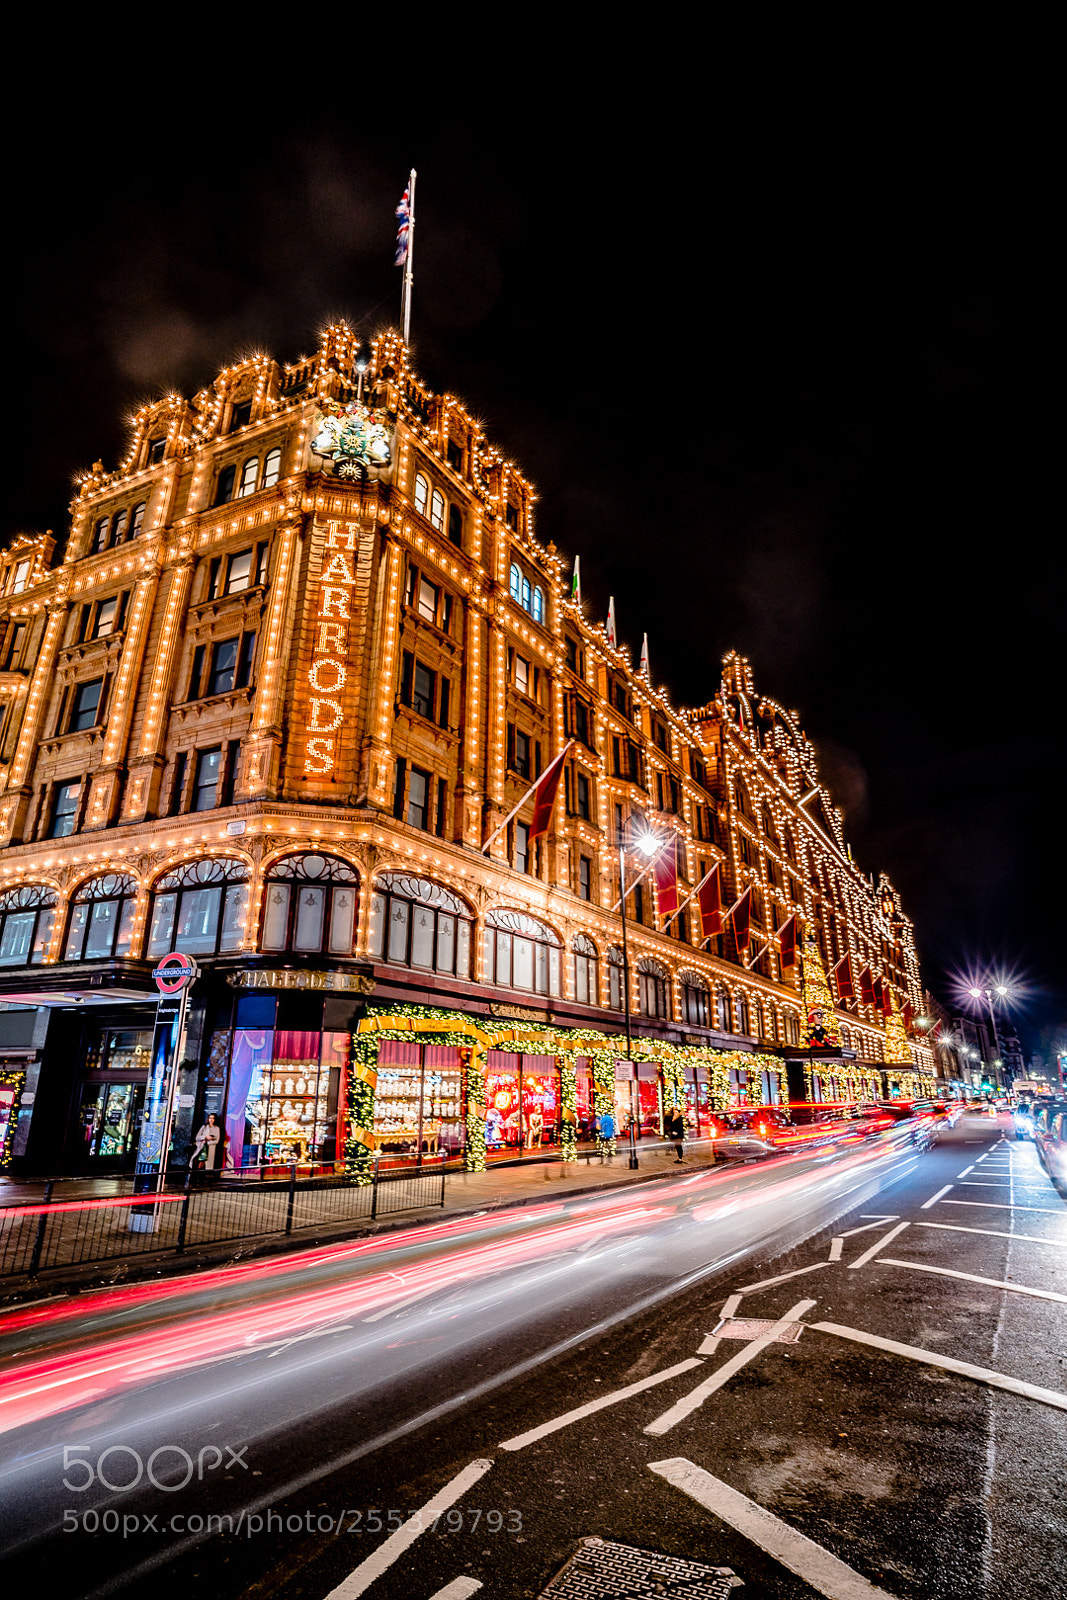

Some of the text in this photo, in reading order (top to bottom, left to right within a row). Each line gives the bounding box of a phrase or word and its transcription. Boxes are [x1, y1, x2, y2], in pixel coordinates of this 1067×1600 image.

[304, 519, 360, 774] HARRODS
[153, 968, 190, 976] UNDERGROUND
[135, 1045, 142, 1055] 6
